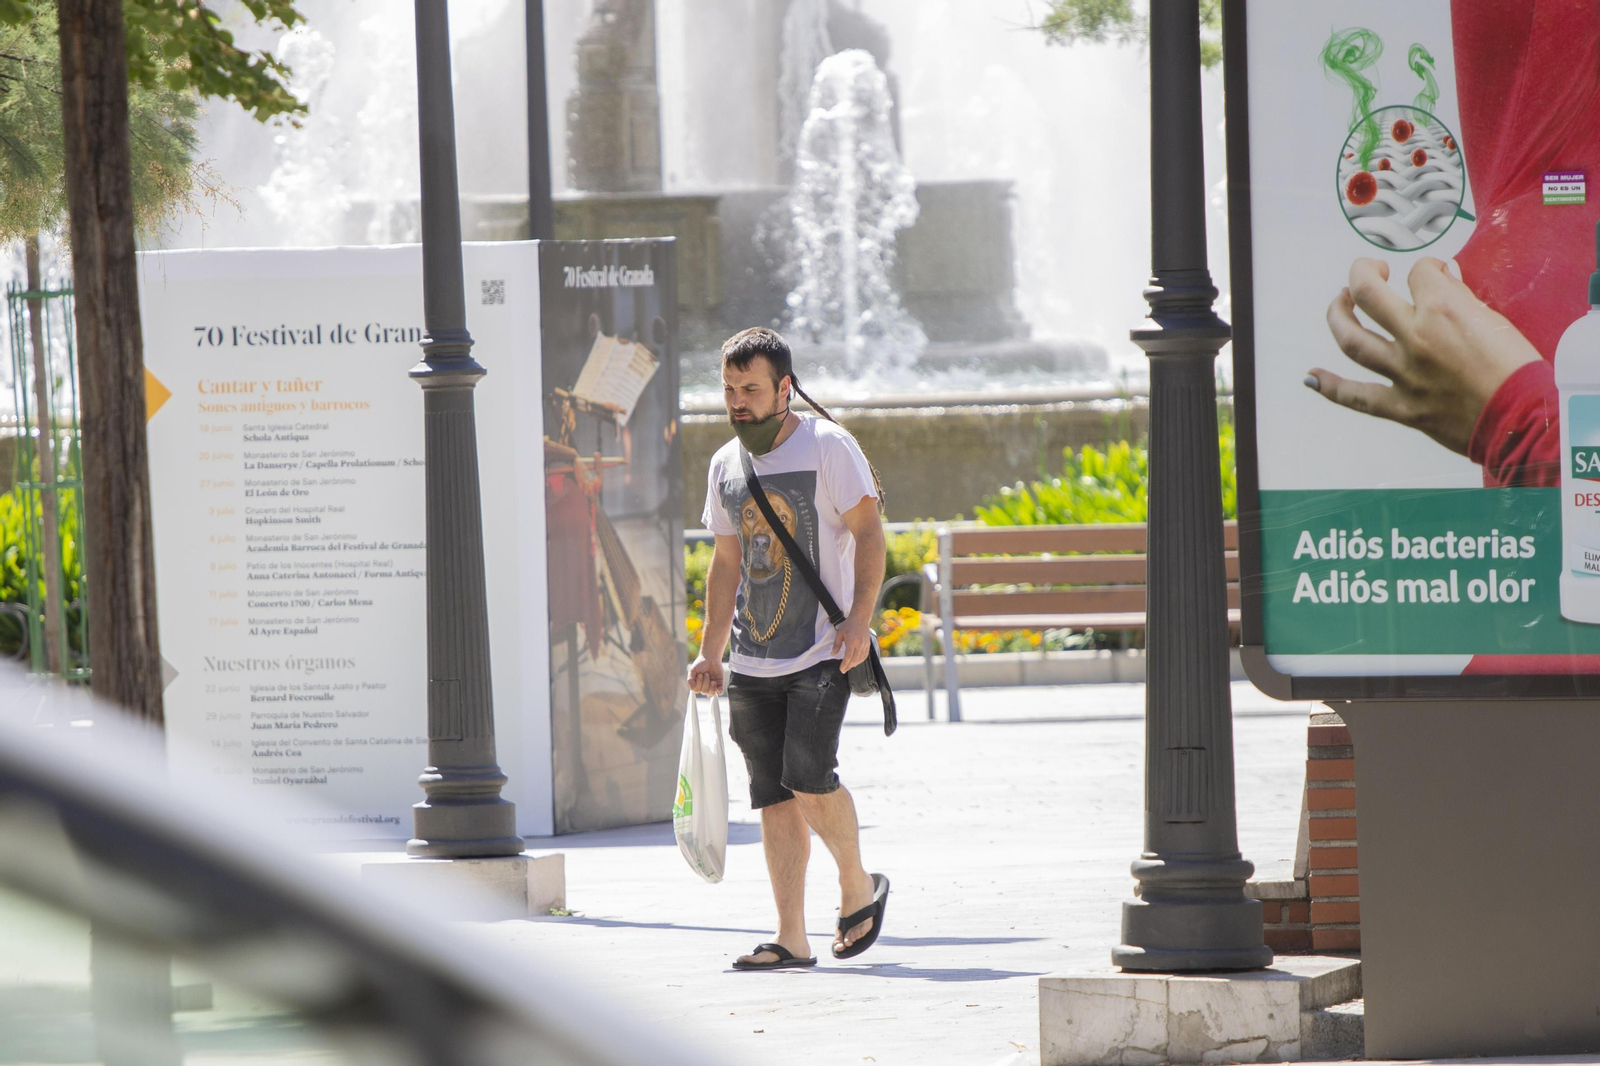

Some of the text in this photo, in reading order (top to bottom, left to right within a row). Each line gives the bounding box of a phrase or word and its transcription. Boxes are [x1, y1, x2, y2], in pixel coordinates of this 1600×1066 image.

[194, 323, 422, 346] 70 Festival de Gran
[198, 377, 323, 397] Cantar y tañer
[241, 400, 296, 415] antiguos
[299, 401, 306, 413] y
[1293, 528, 1535, 560] Adiós bacterias
[1292, 569, 1535, 603] Adiós mal olor
[204, 655, 356, 674] Nuestros órganos
[356, 683, 360, 691] y
